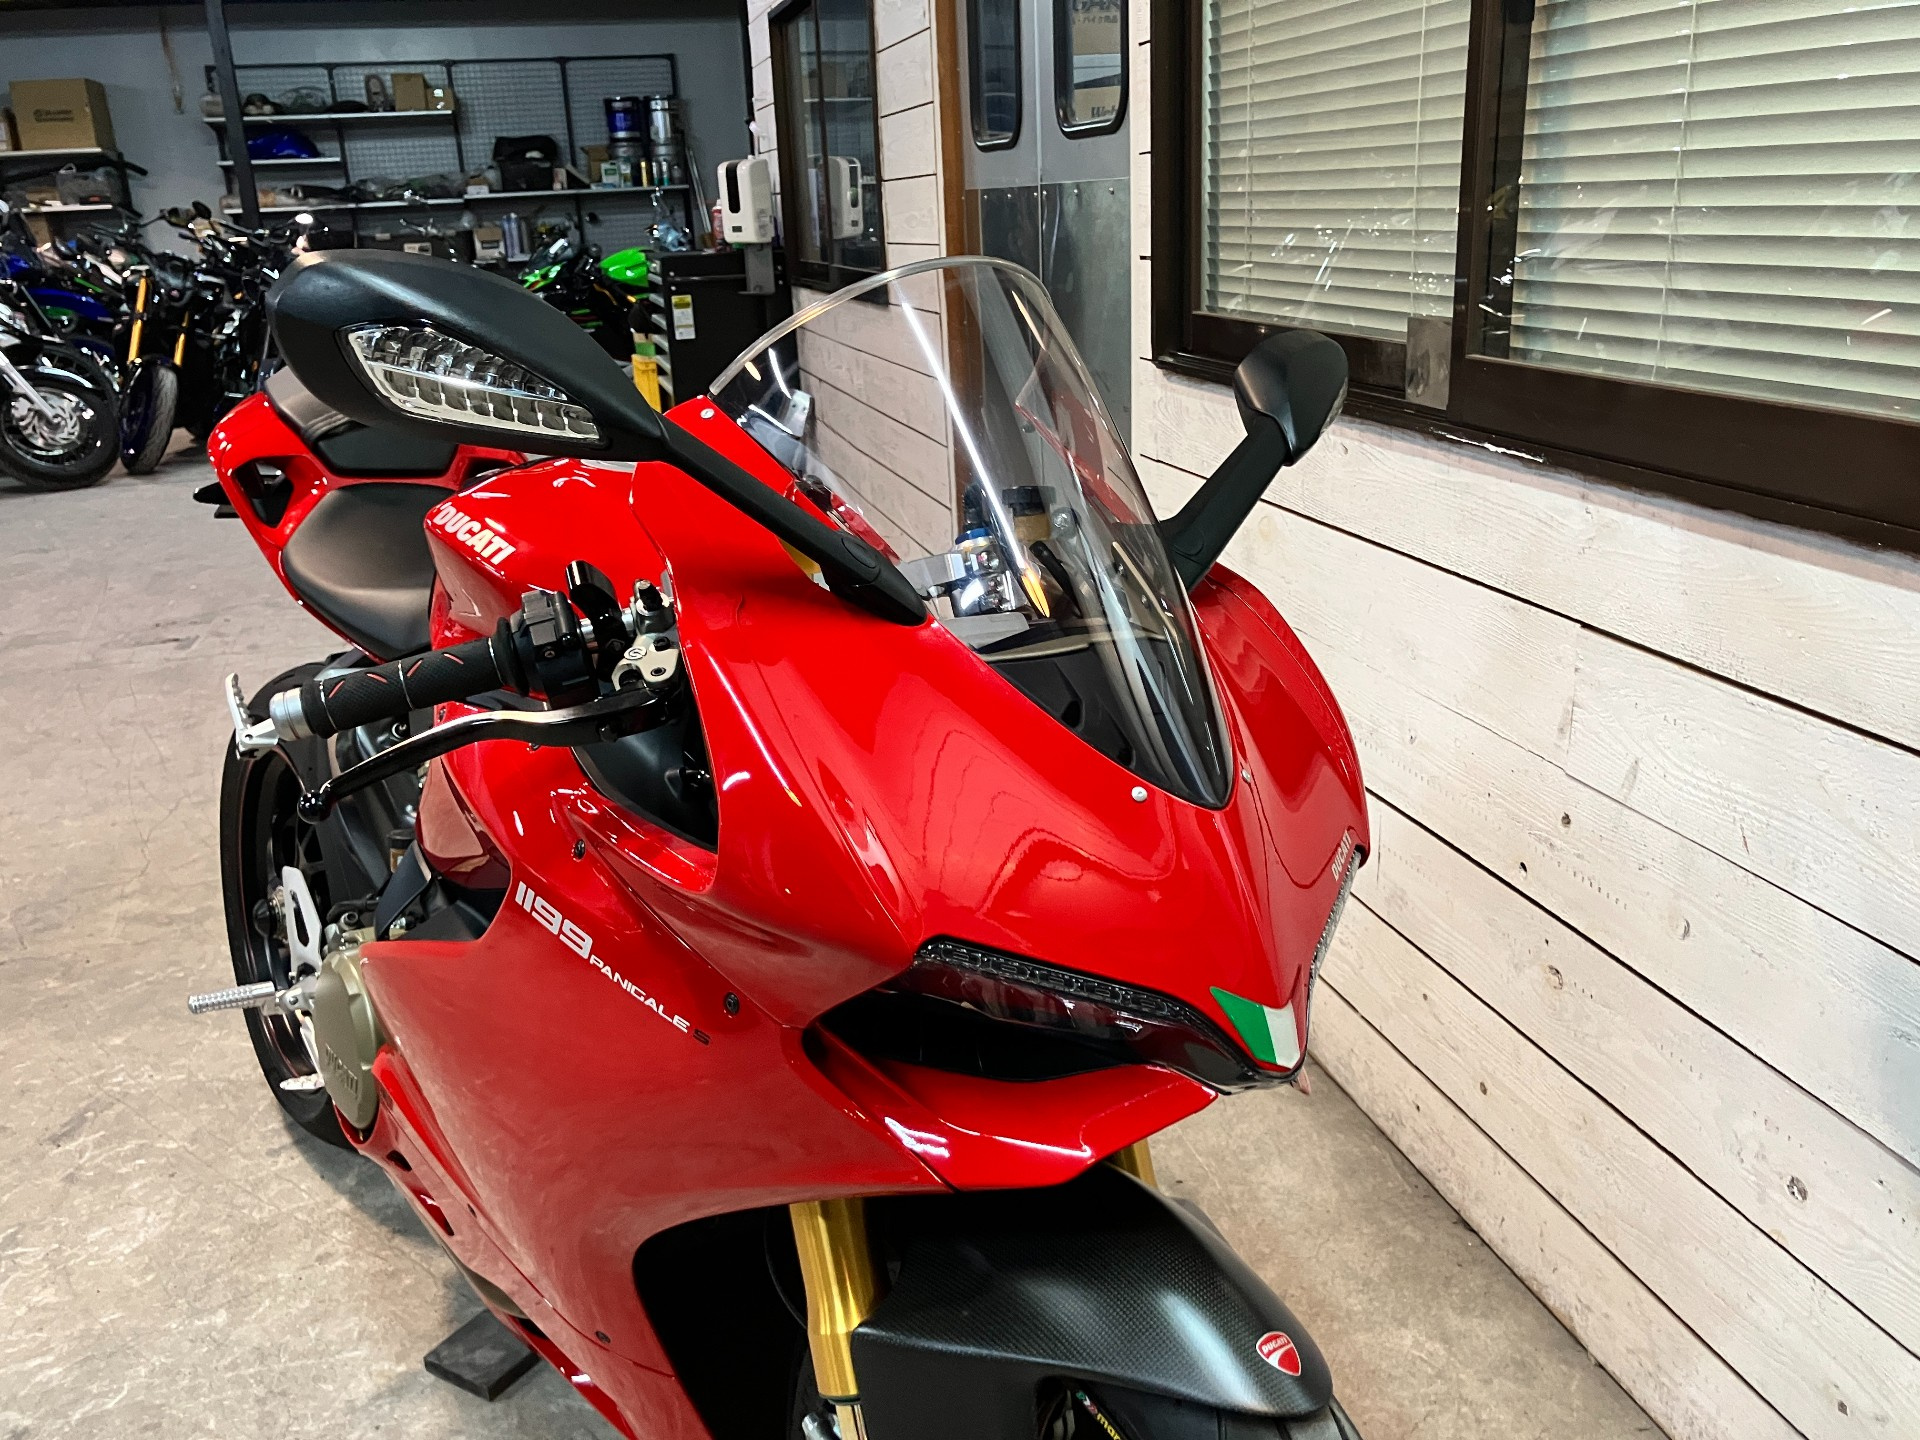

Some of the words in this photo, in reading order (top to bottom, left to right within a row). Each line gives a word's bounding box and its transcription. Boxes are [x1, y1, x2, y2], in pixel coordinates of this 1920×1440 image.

[433, 504, 517, 566] DUCATI
[515, 880, 593, 960] 1199
[589, 954, 691, 1033] PANIGALE
[692, 1027, 711, 1046] S
[1261, 1336, 1288, 1354] DUCATI
